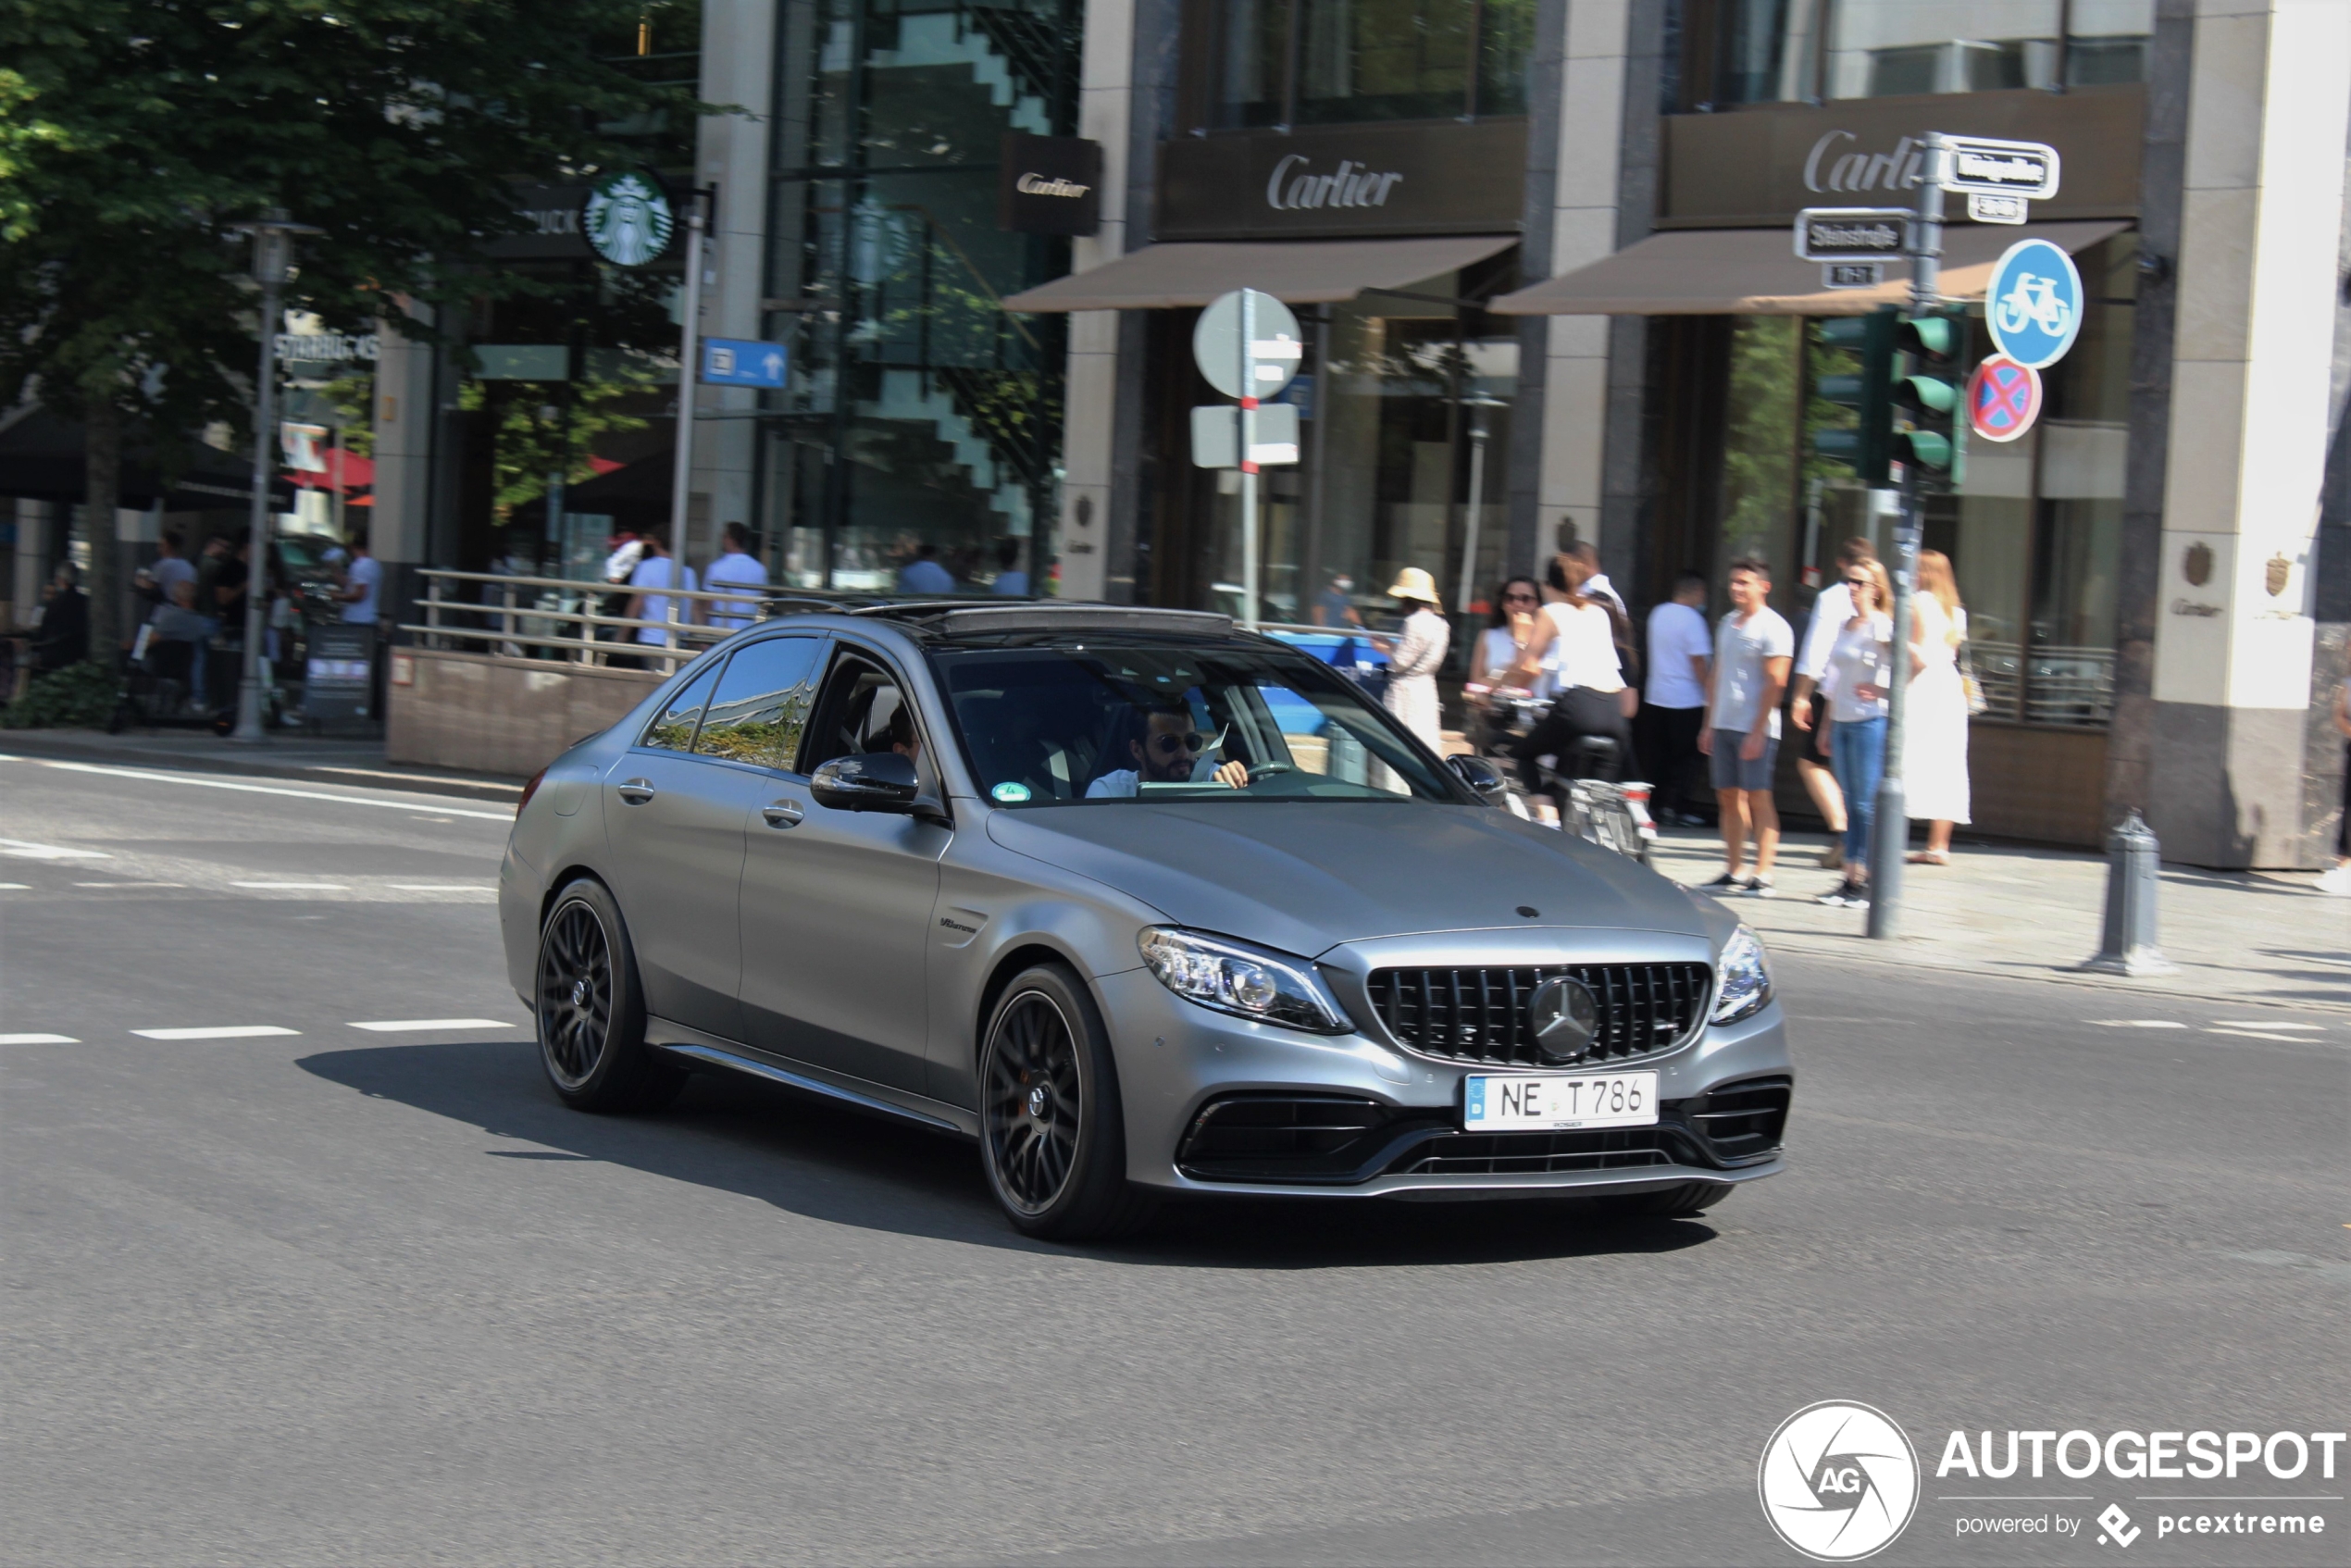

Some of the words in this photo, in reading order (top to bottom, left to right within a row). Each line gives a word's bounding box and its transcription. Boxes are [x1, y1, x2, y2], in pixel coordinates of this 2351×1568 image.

[1802, 130, 1924, 194] Carti
[1016, 172, 1091, 198] Cartier
[1267, 154, 1404, 211] Cartier
[1005, 785, 1015, 794] 4
[1471, 1103, 1482, 1114] D
[1501, 1083, 1541, 1116] NE
[1568, 1081, 1584, 1114] T
[1593, 1079, 1642, 1114] 786
